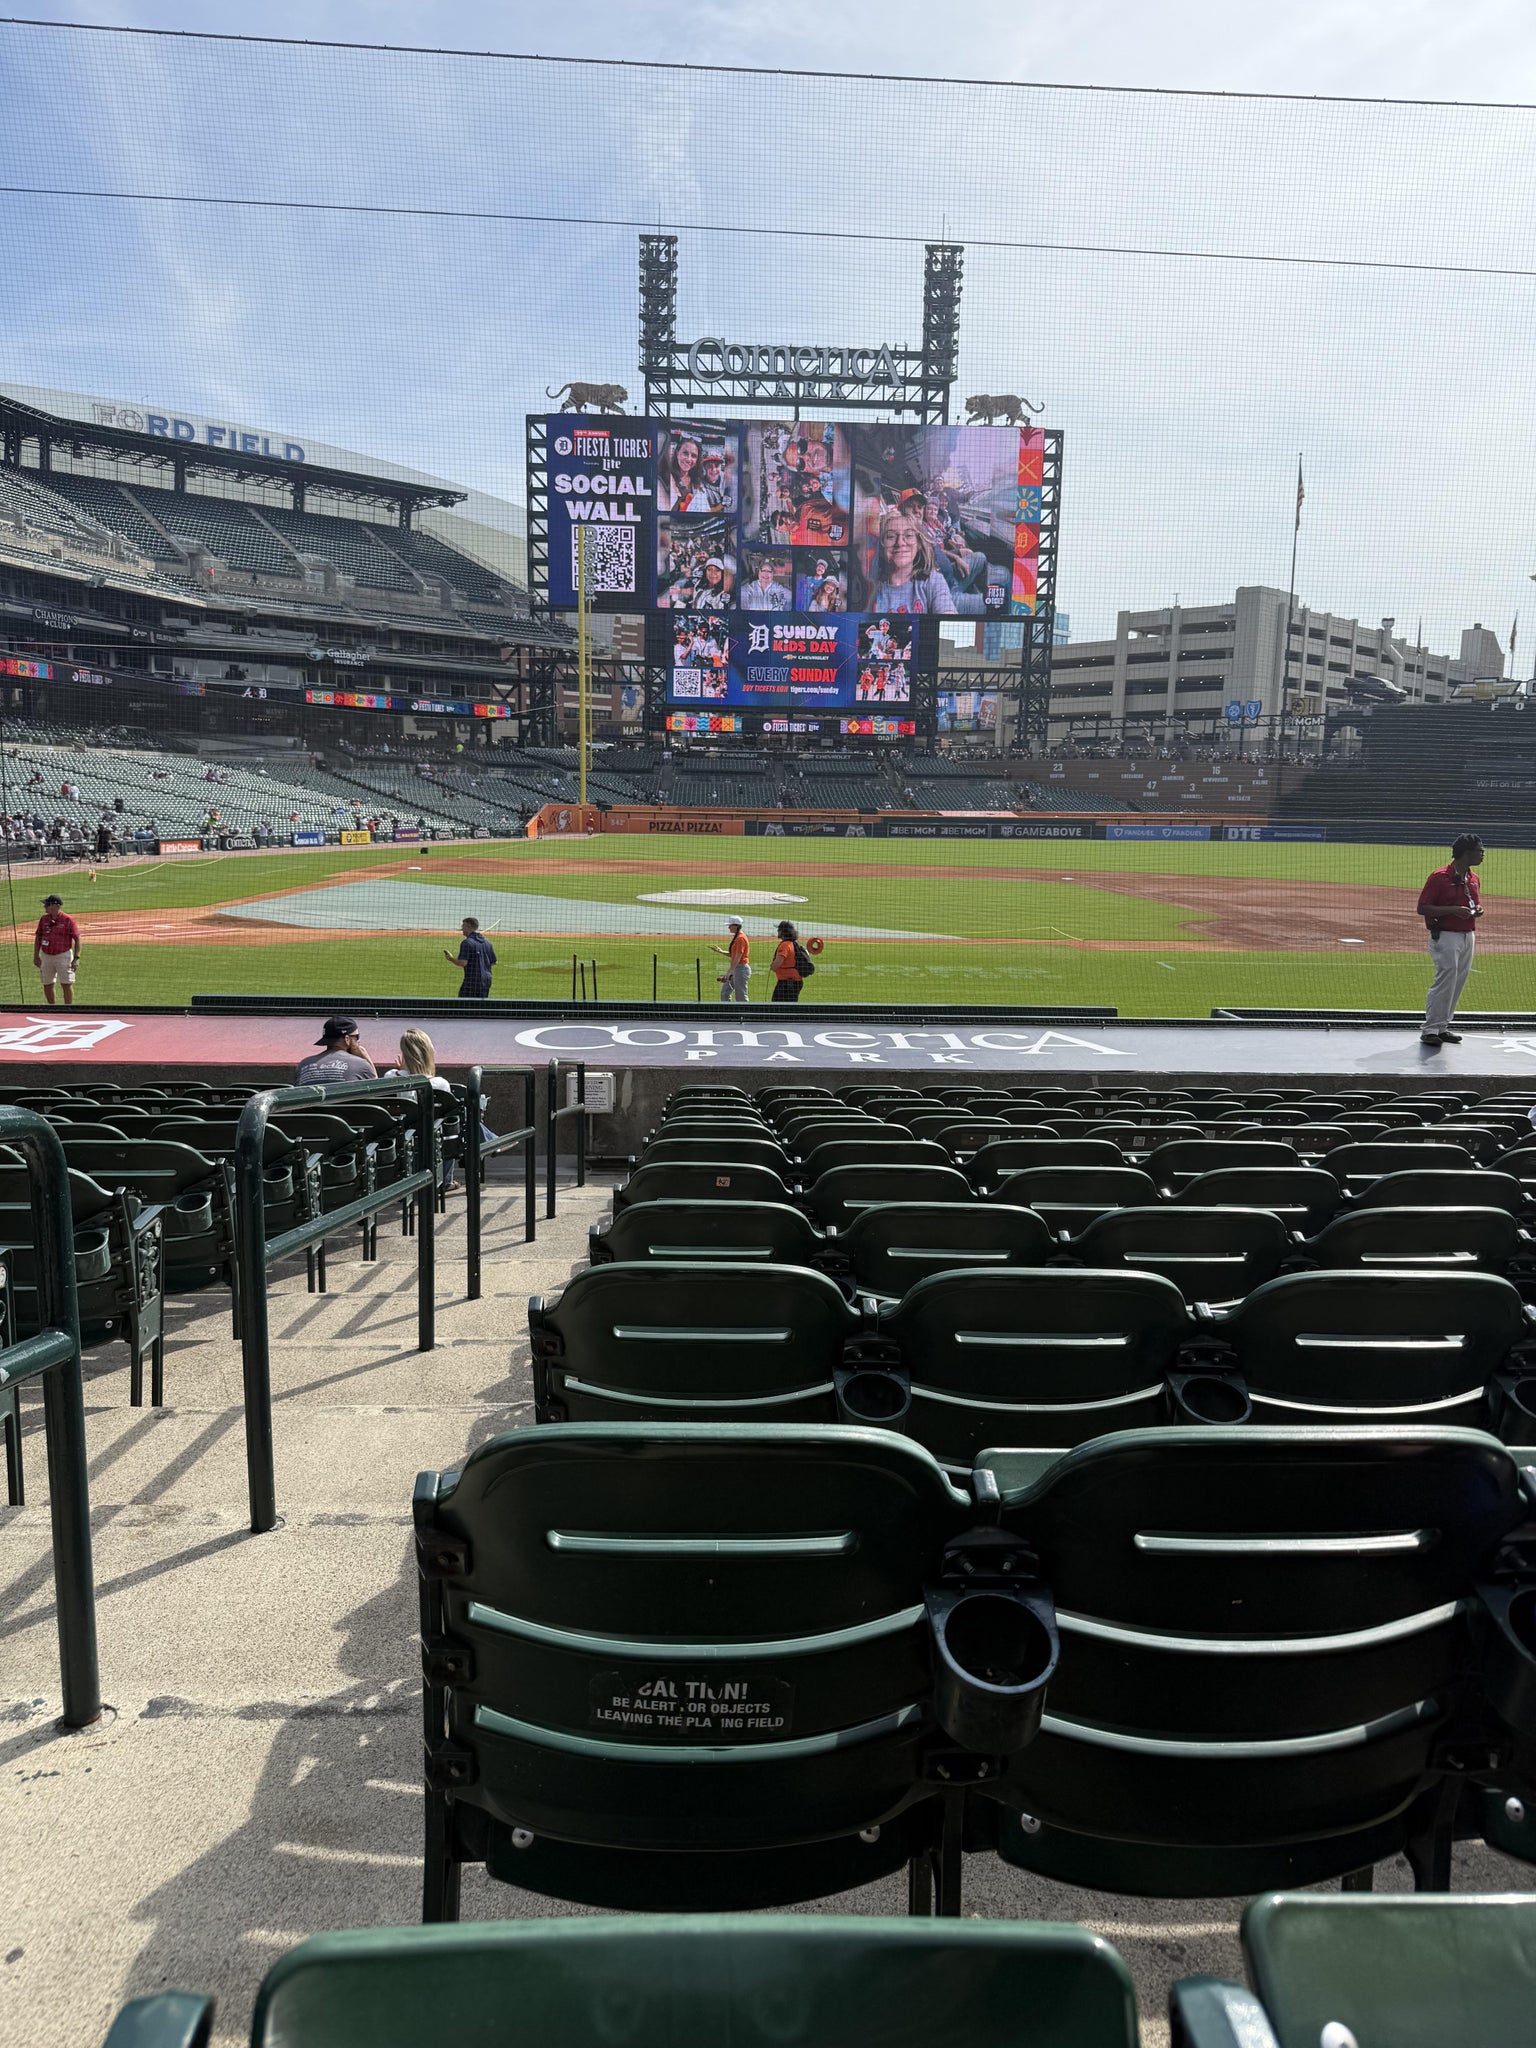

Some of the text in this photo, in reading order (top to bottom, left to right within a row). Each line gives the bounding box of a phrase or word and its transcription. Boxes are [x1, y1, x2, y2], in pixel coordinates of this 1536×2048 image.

[749, 379, 847, 399] PARK
[92, 404, 306, 463] FORD FIELD
[613, 438, 652, 458] TIGRES!
[602, 458, 621, 471] Lite
[554, 473, 652, 496] SOCIAL
[565, 500, 641, 522] WALL
[34, 608, 78, 625] CHAMPIONS
[50, 620, 66, 629] CLUB
[773, 625, 839, 640] SUNDAY
[809, 641, 838, 653] DAY
[327, 649, 371, 662] Gallagher
[334, 659, 364, 667] INSURANCE
[747, 666, 838, 682] EVERY SUNDAY
[754, 685, 776, 693] TICKETS
[790, 686, 840, 695] tigers.com/sunday
[1053, 763, 1063, 772] 23
[1130, 763, 1136, 771] 5
[1170, 764, 1177, 773] 2
[1212, 766, 1221, 775] 16
[1258, 768, 1264, 777] 6
[1146, 781, 1157, 790] 47
[1189, 783, 1196, 792] 3
[1238, 784, 1242, 793] 1
[649, 822, 723, 833] PIZZA! PIZZA!
[899, 827, 986, 836] BETMGM BETMGM
[1015, 827, 1082, 837] GAMEABOVE
[1228, 827, 1262, 840] DTE
[684, 1050, 974, 1063] PARK
[612, 1696, 771, 1714] BE ALERT OR OBJECTS
[597, 1708, 784, 1728] LEAVING THE PLAING FIELD
